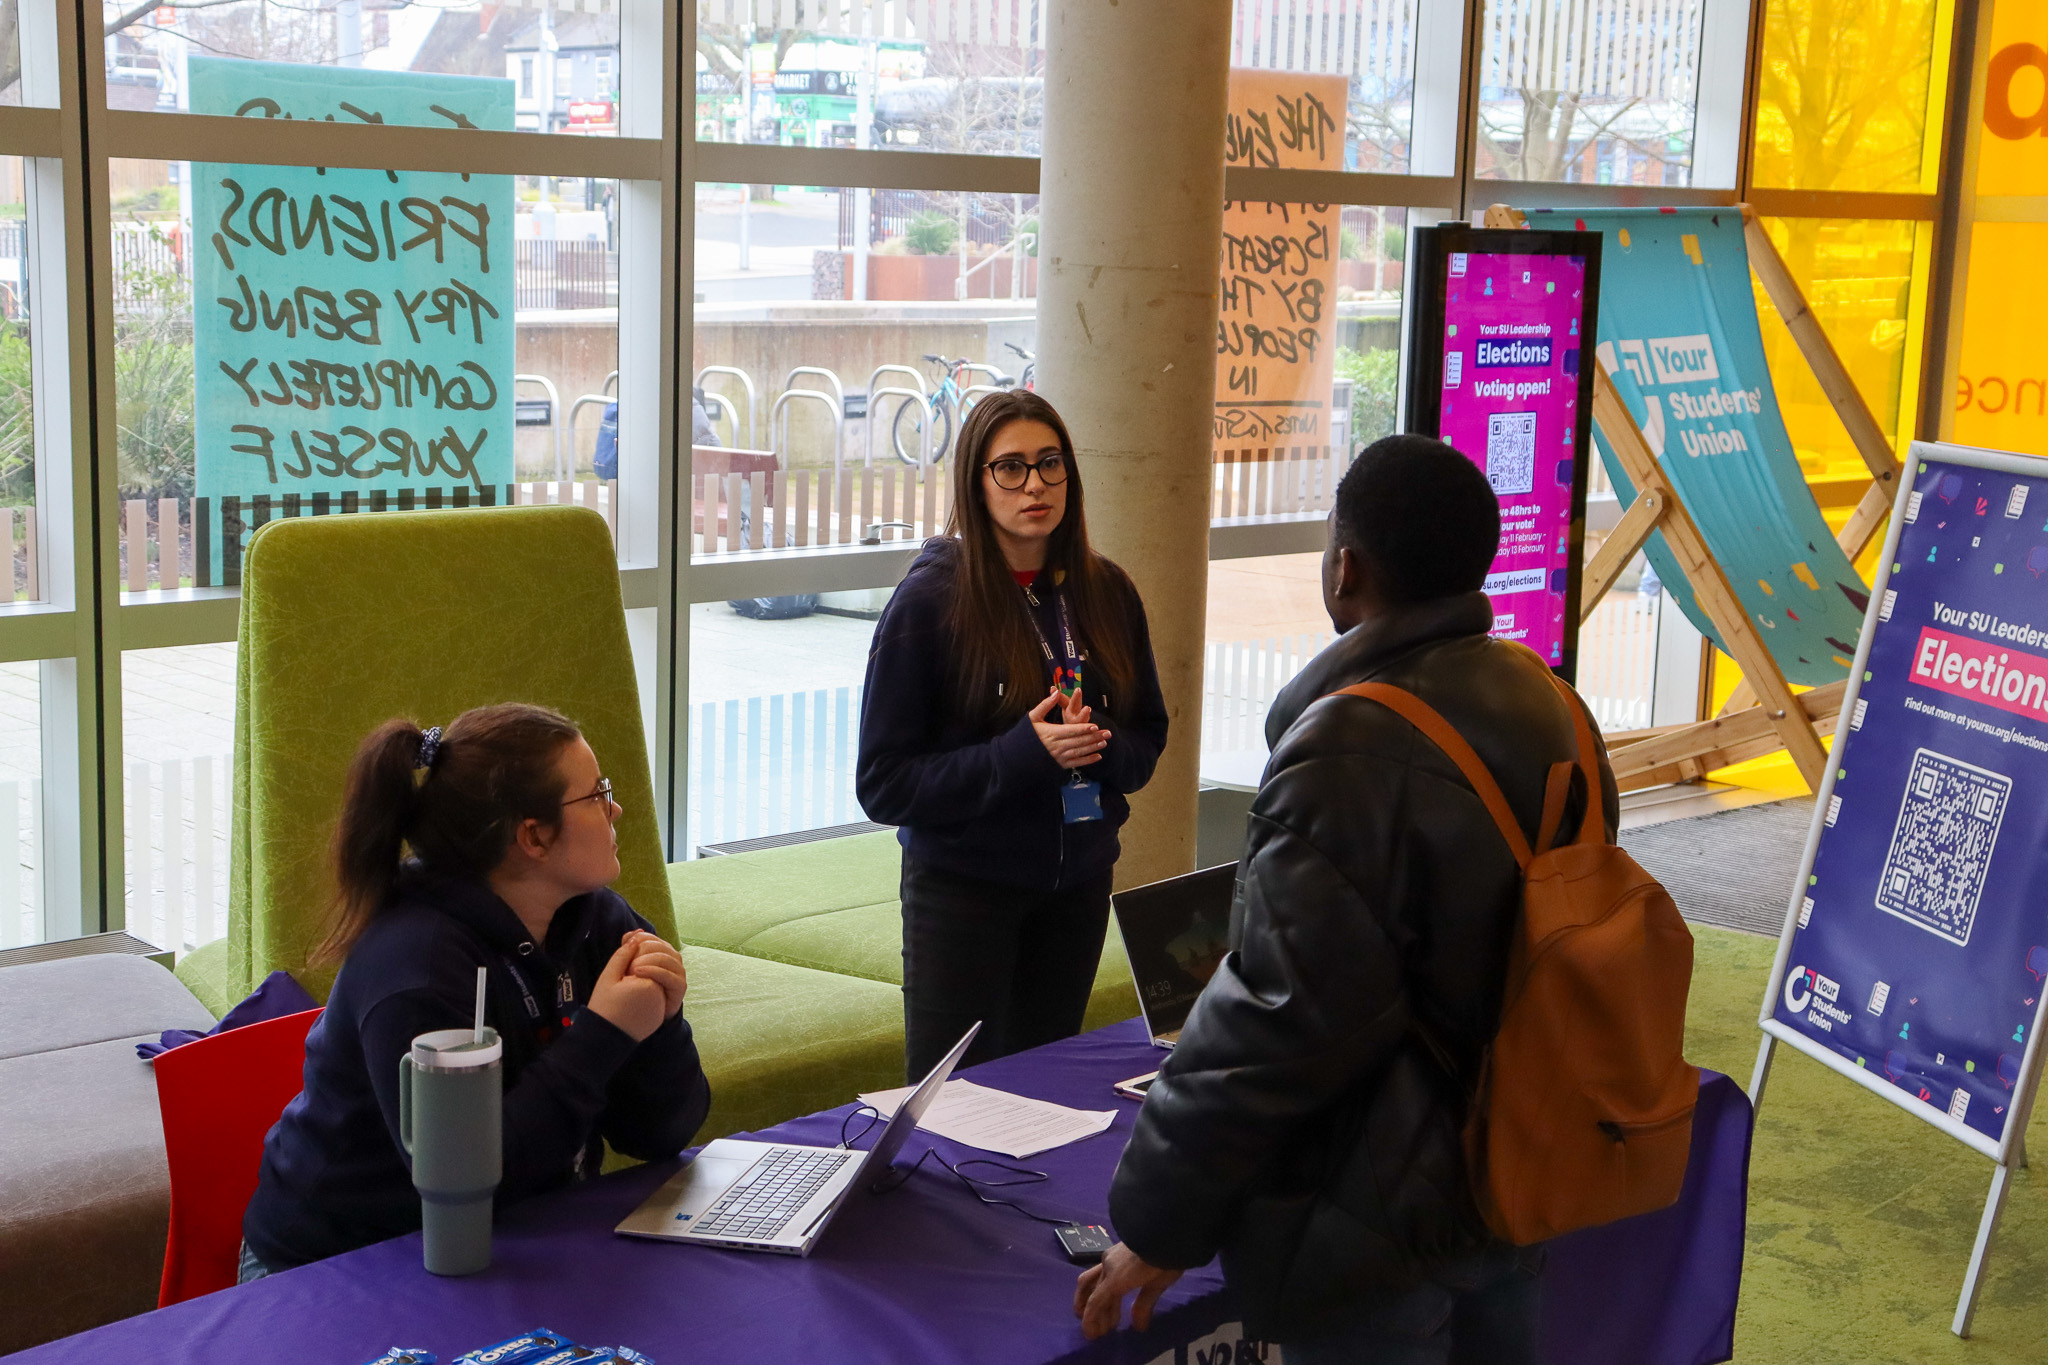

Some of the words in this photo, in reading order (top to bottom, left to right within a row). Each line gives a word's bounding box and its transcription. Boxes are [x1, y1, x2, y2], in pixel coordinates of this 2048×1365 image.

[1480, 324, 1498, 335] Your
[1499, 323, 1510, 335] SU
[1510, 322, 1551, 337] Leadership
[1477, 340, 1550, 364] Elections
[1655, 346, 1708, 374] Your
[1474, 378, 1515, 401] Voting
[1516, 377, 1551, 400] open!
[1680, 422, 1748, 458] Union
[1510, 505, 1532, 516] 48hrs
[1533, 504, 1541, 514] to
[1500, 521, 1515, 532] our
[1515, 518, 1536, 530] vote!
[1515, 532, 1543, 542] February
[1511, 545, 1518, 554] 13
[1482, 575, 1542, 591] su.org/elections
[1496, 617, 1513, 627] Your
[1934, 601, 1969, 628] Your
[1968, 611, 1991, 633] SU
[1904, 697, 1922, 711] Find
[1922, 704, 1935, 716] out
[1935, 708, 1956, 722] more
[1956, 715, 1966, 725] at
[1146, 980, 1172, 1000] 14:39
[1818, 979, 1836, 997] Your
[1808, 1009, 1832, 1032] Union
[1812, 995, 1852, 1025] Students'
[479, 1337, 534, 1363] OREO
